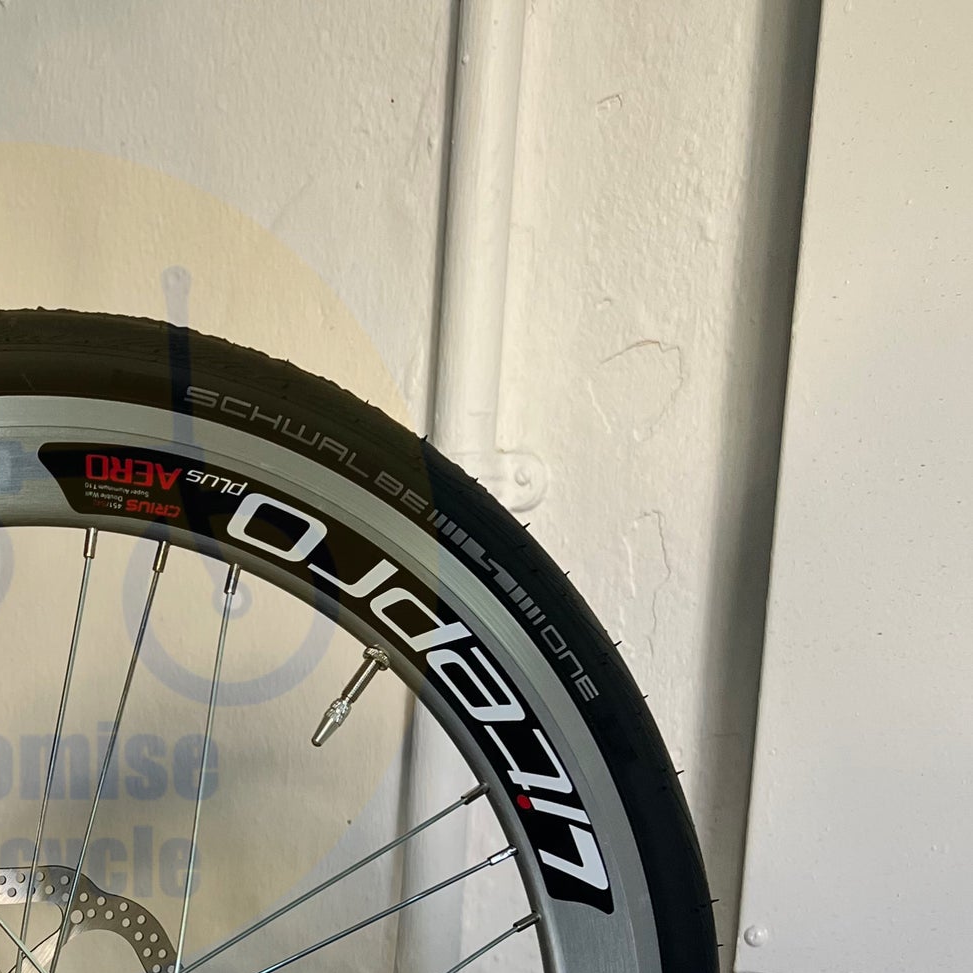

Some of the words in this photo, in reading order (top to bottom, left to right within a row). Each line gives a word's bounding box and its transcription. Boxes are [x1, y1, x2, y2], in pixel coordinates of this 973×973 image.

[85, 454, 183, 490] AERO
[125, 499, 181, 518] CRIUS
[184, 385, 429, 515] SCHWALBE
[541, 624, 600, 702] ONE
